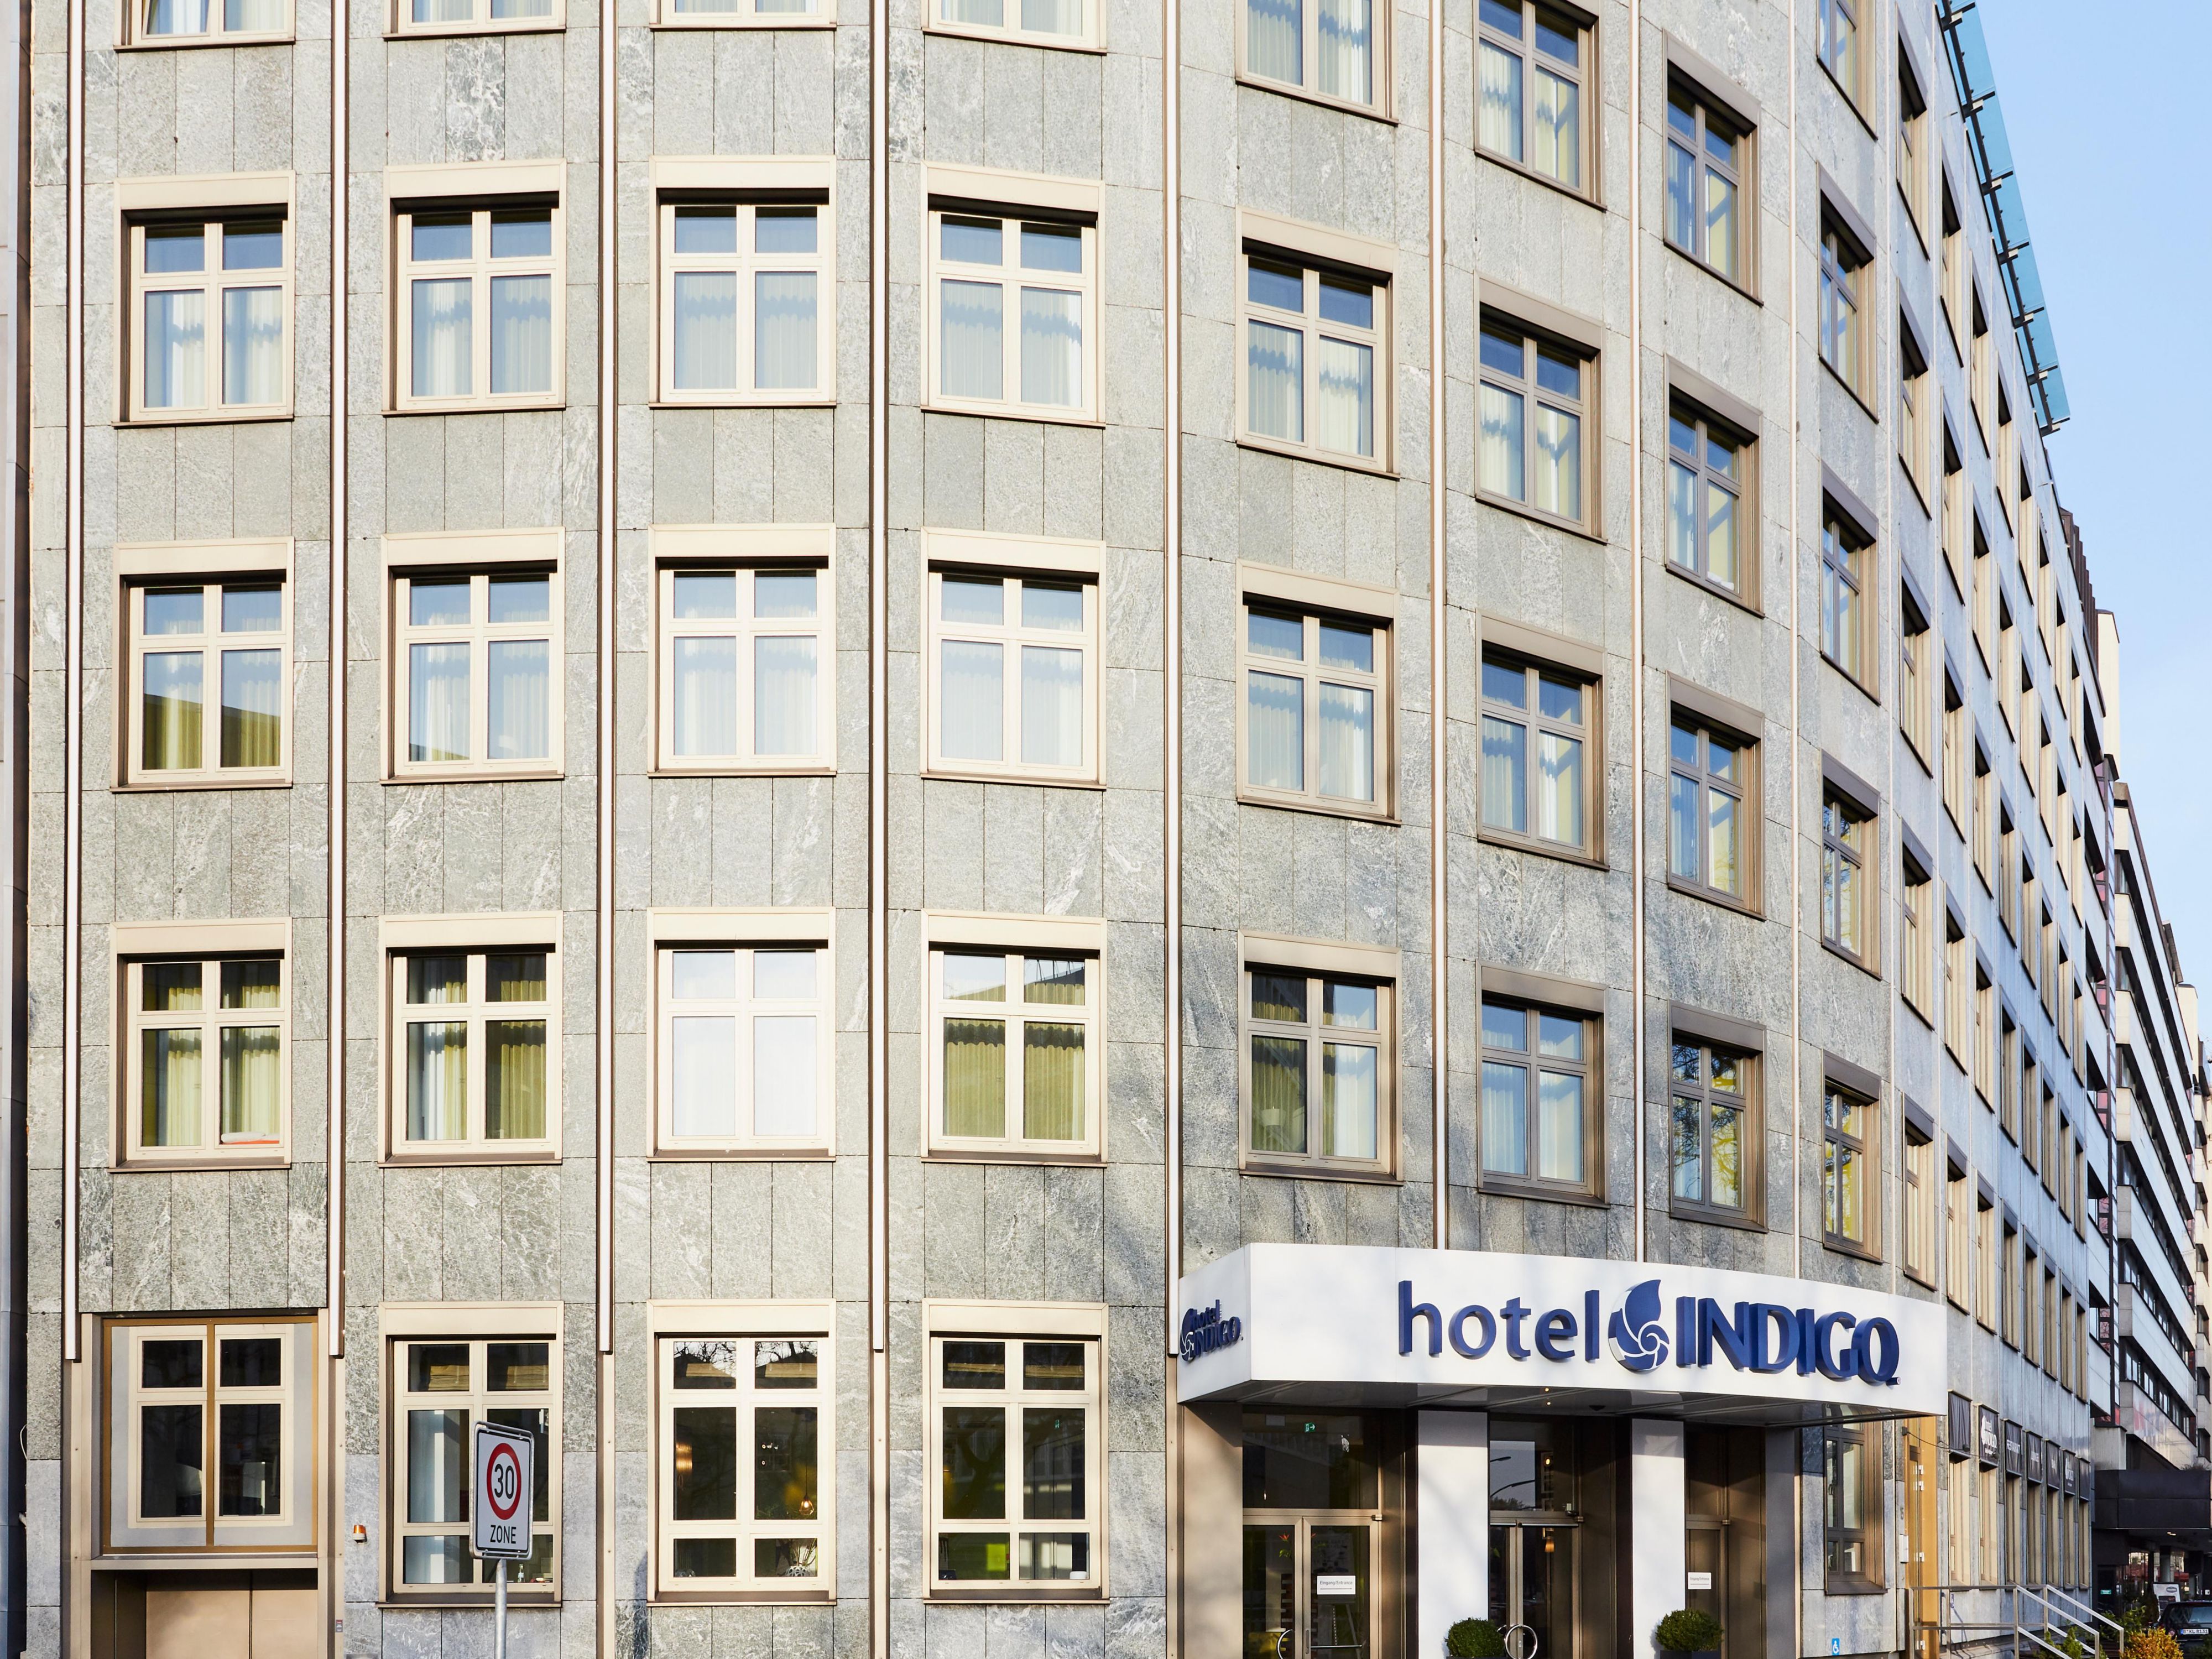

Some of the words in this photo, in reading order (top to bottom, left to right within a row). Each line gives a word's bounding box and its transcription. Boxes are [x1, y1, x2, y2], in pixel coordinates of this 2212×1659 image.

[1399, 1280, 1600, 1362] hotel
[1676, 1296, 1900, 1386] INDIGO
[494, 1464, 514, 1499] 30
[490, 1525, 517, 1544] ZONE
